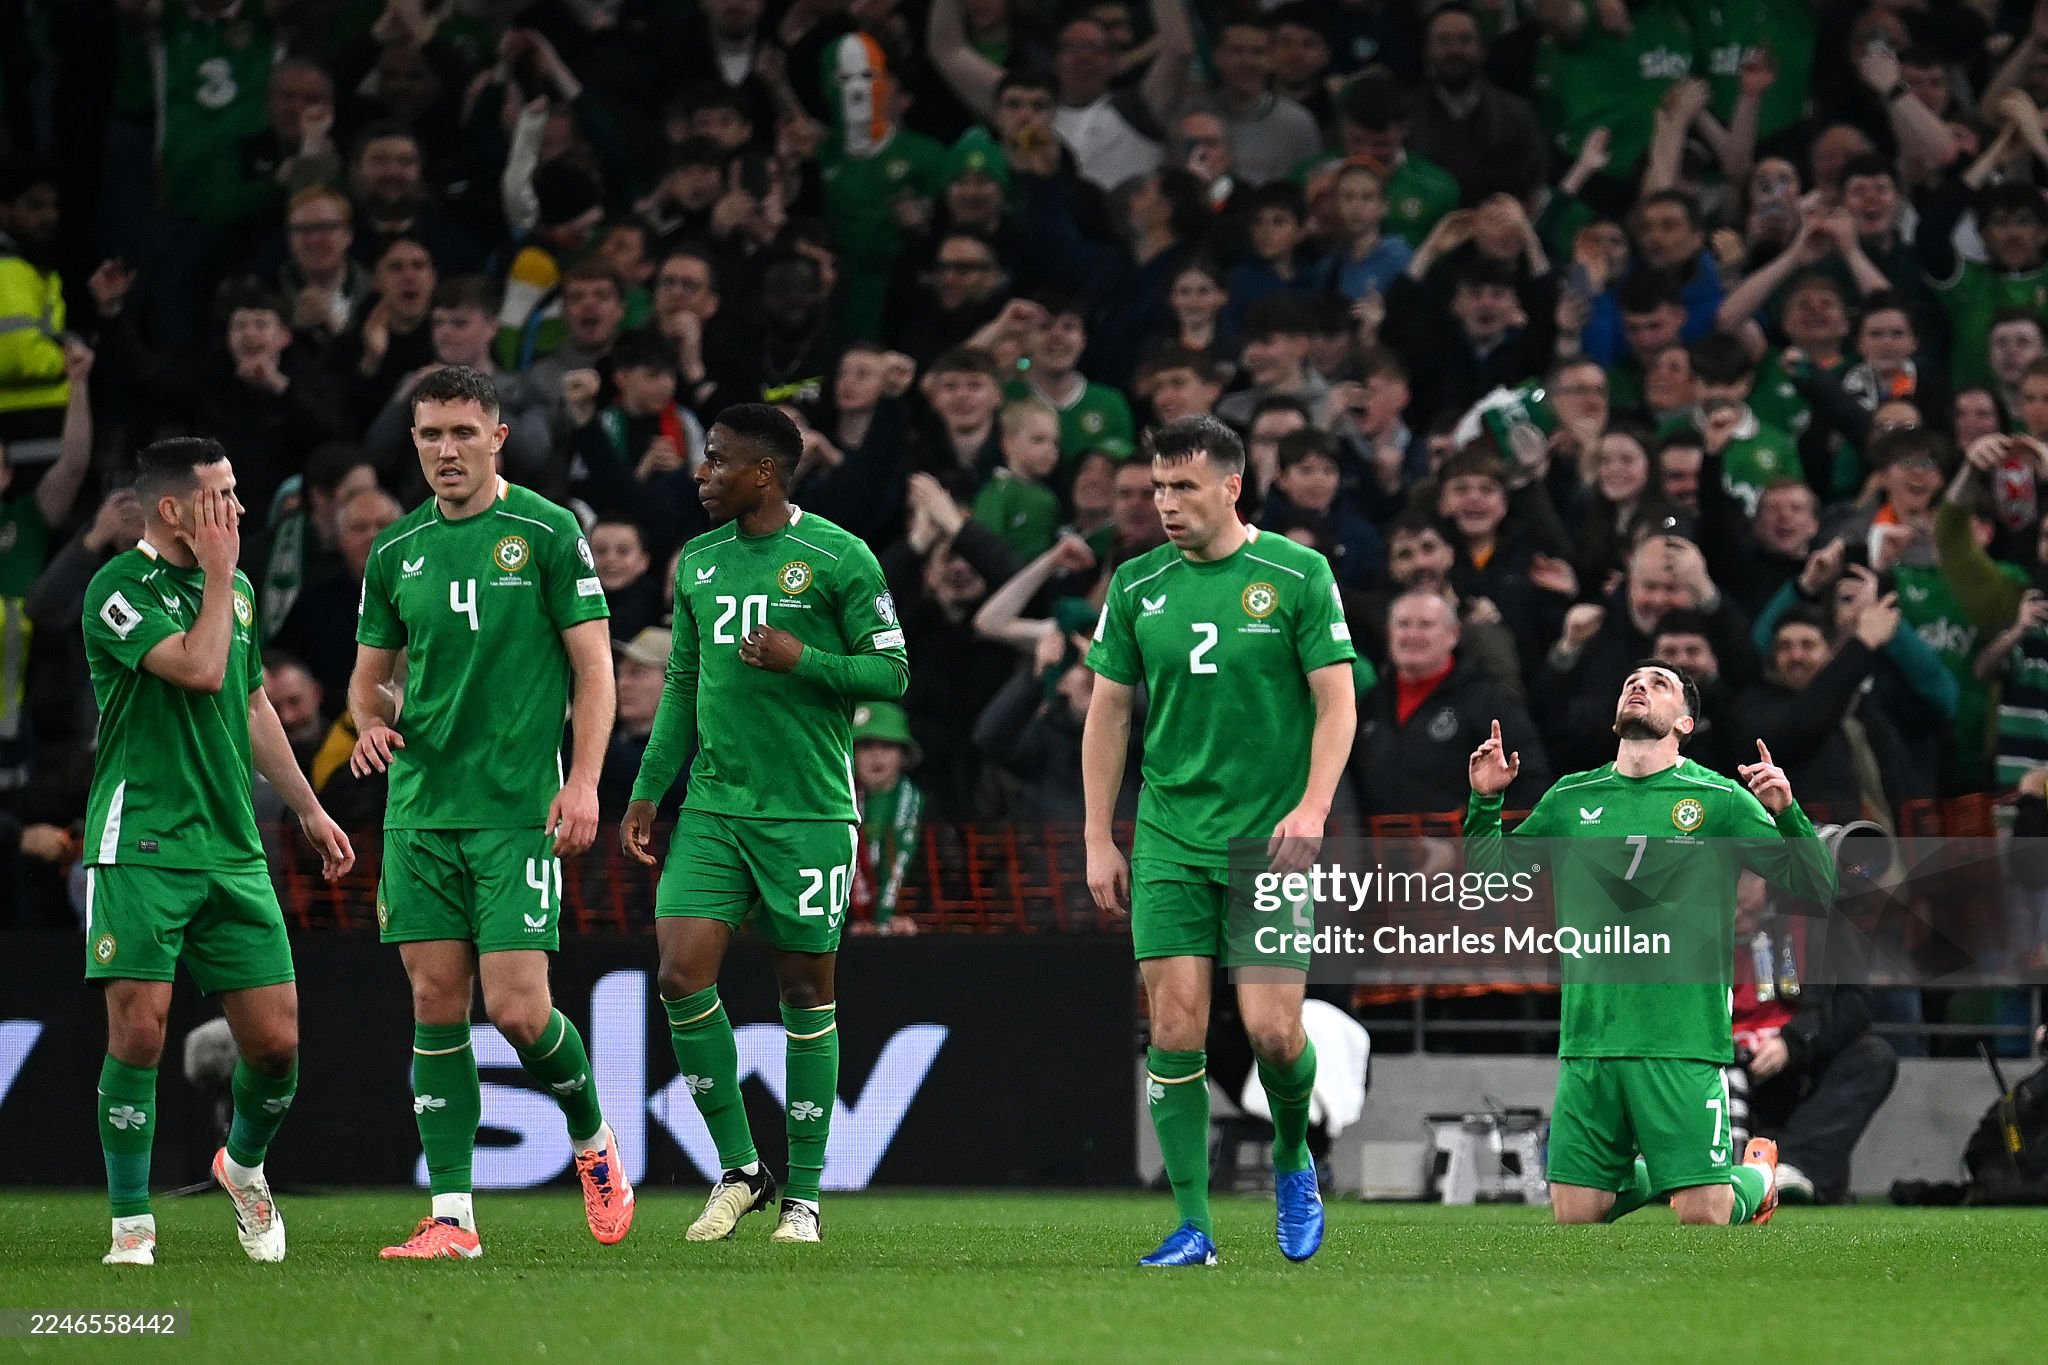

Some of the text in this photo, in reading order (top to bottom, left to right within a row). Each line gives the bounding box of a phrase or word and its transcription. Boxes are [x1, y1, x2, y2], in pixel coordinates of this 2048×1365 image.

[196, 57, 238, 109] 3
[450, 578, 479, 631] 4
[714, 594, 768, 645] 20
[1189, 622, 1219, 674] 2
[526, 857, 550, 909] 4
[1624, 835, 1648, 880] 7
[799, 864, 847, 917] 20
[411, 968, 951, 1191] sky
[1705, 1098, 1722, 1147] 7
